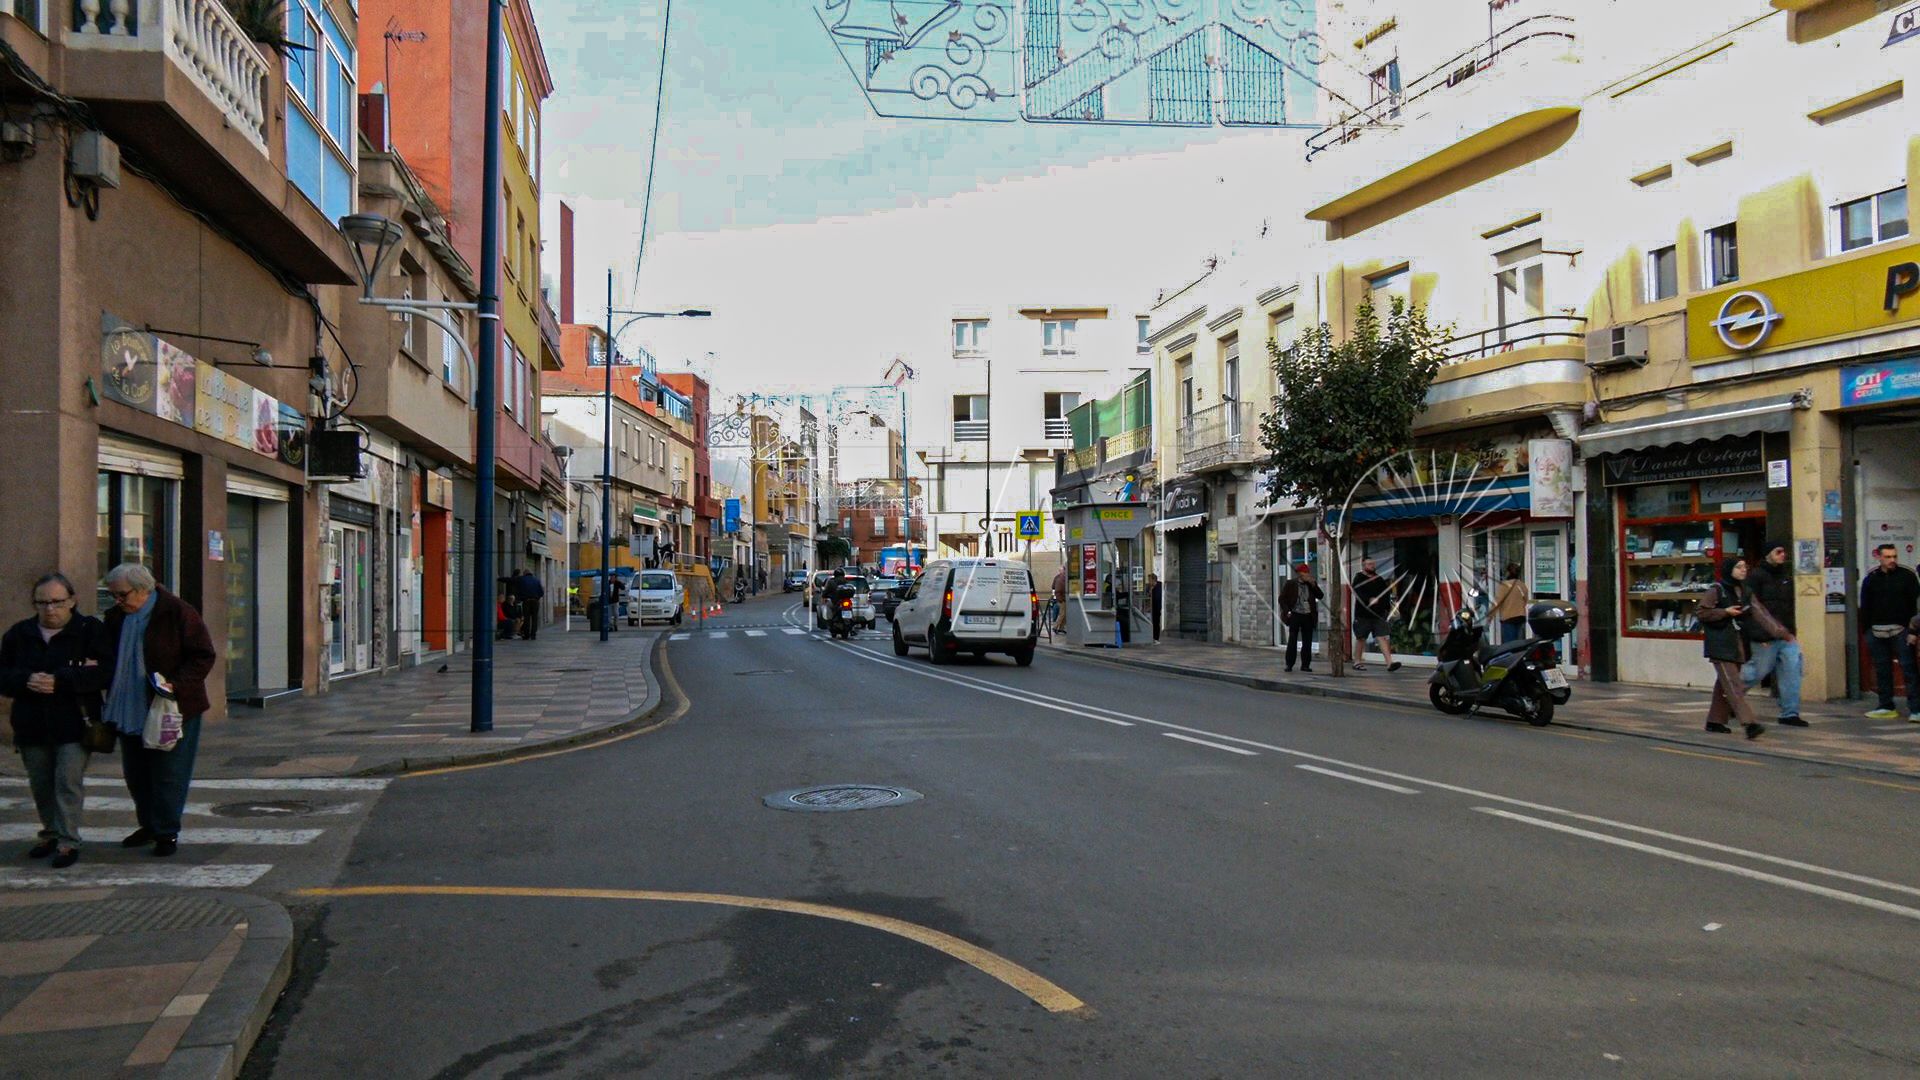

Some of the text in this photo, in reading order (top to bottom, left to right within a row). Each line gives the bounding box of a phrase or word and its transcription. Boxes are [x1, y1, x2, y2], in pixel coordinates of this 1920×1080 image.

[1855, 373, 1880, 386] OTI
[1632, 447, 1760, 473] David Ortega
[1103, 511, 1129, 519] ONCE
